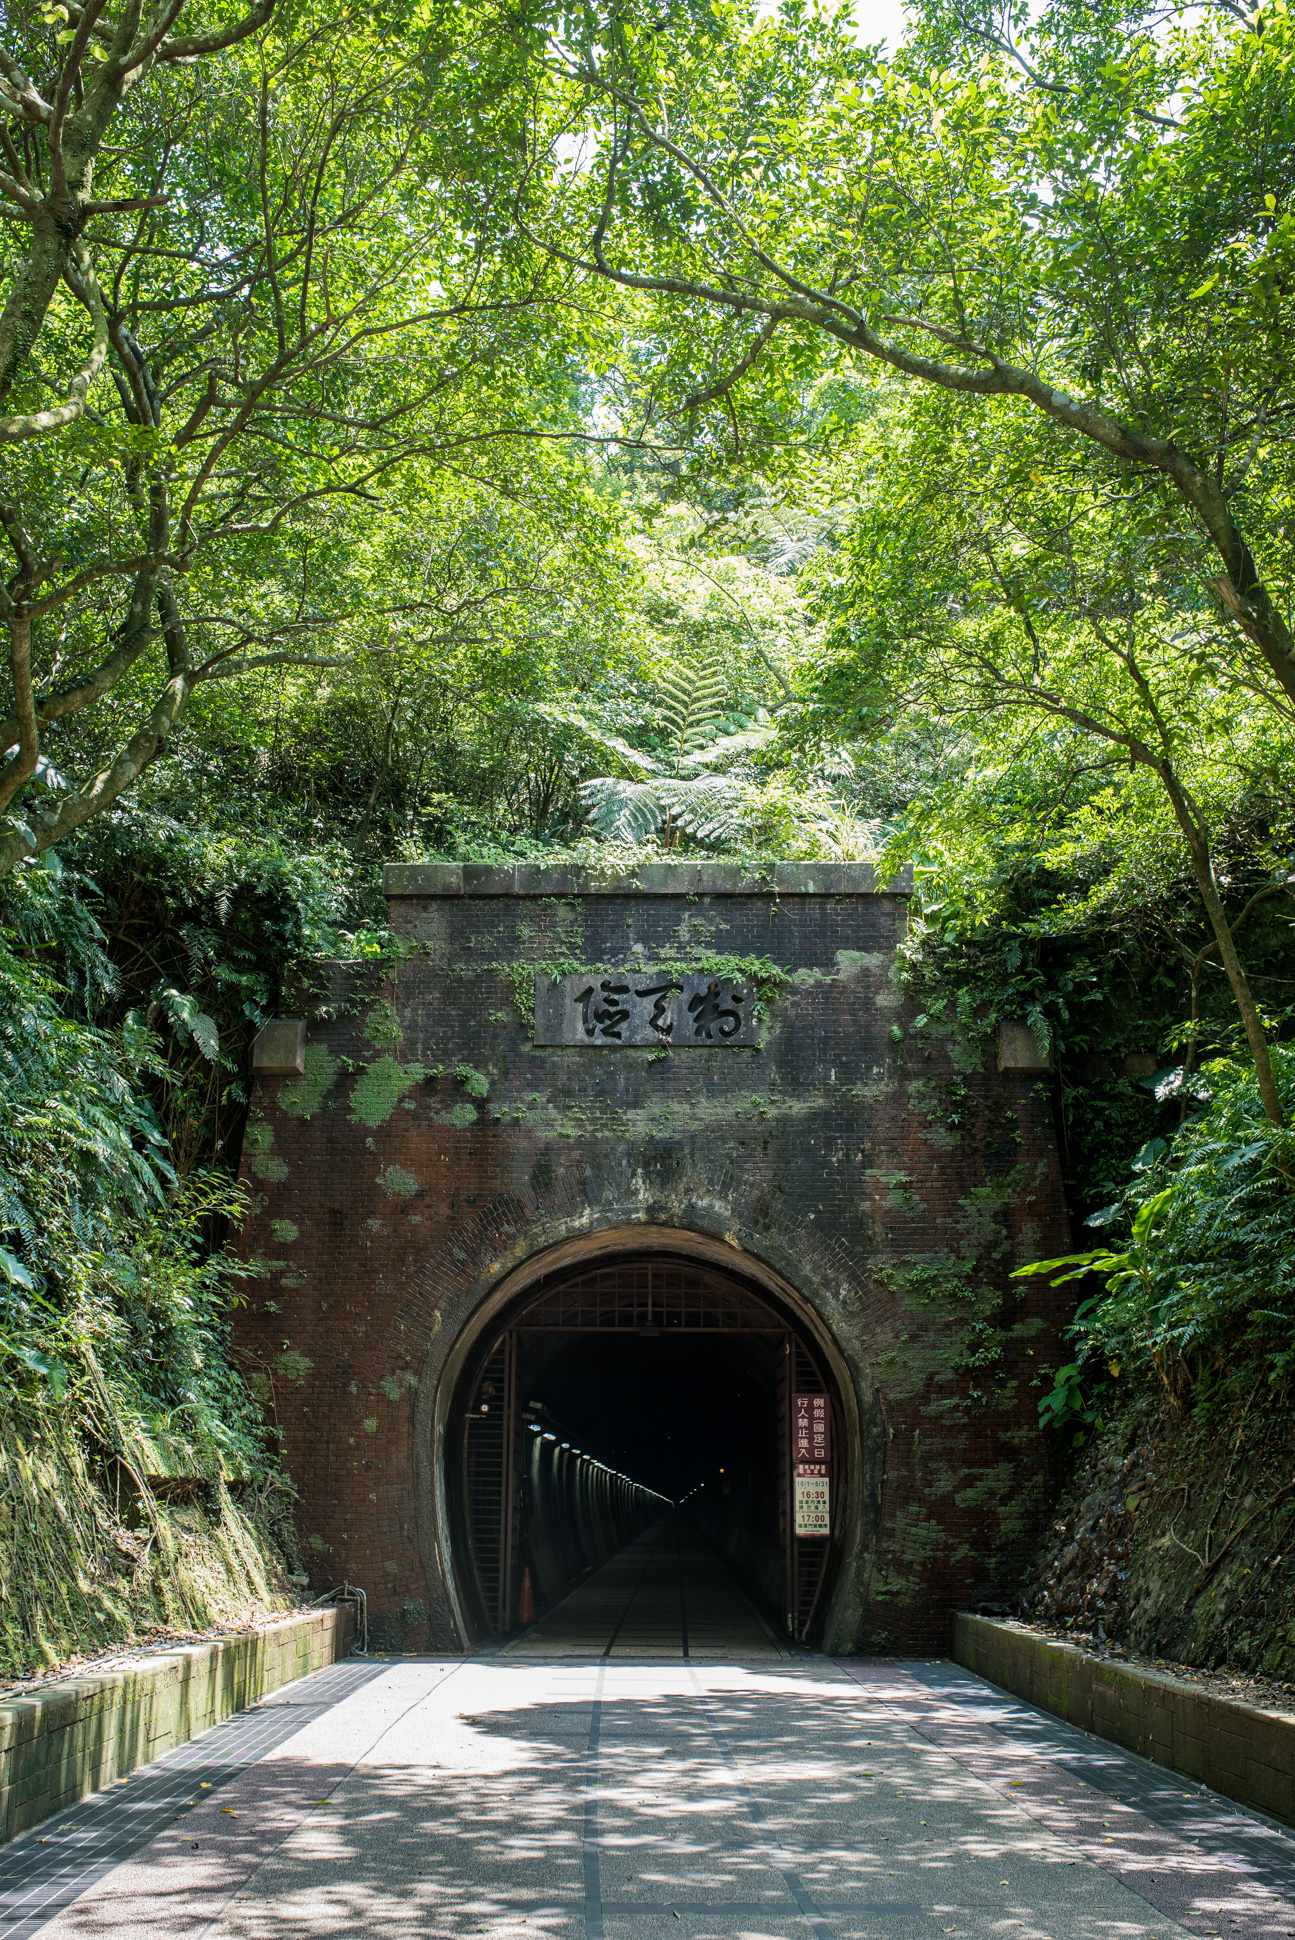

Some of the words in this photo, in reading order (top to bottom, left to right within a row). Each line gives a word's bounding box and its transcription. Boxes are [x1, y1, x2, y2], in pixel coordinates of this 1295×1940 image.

[797, 1398, 809, 1458] 行人禁止進入
[801, 1491, 825, 1499] 16:30
[801, 1514, 825, 1522] 17:00
